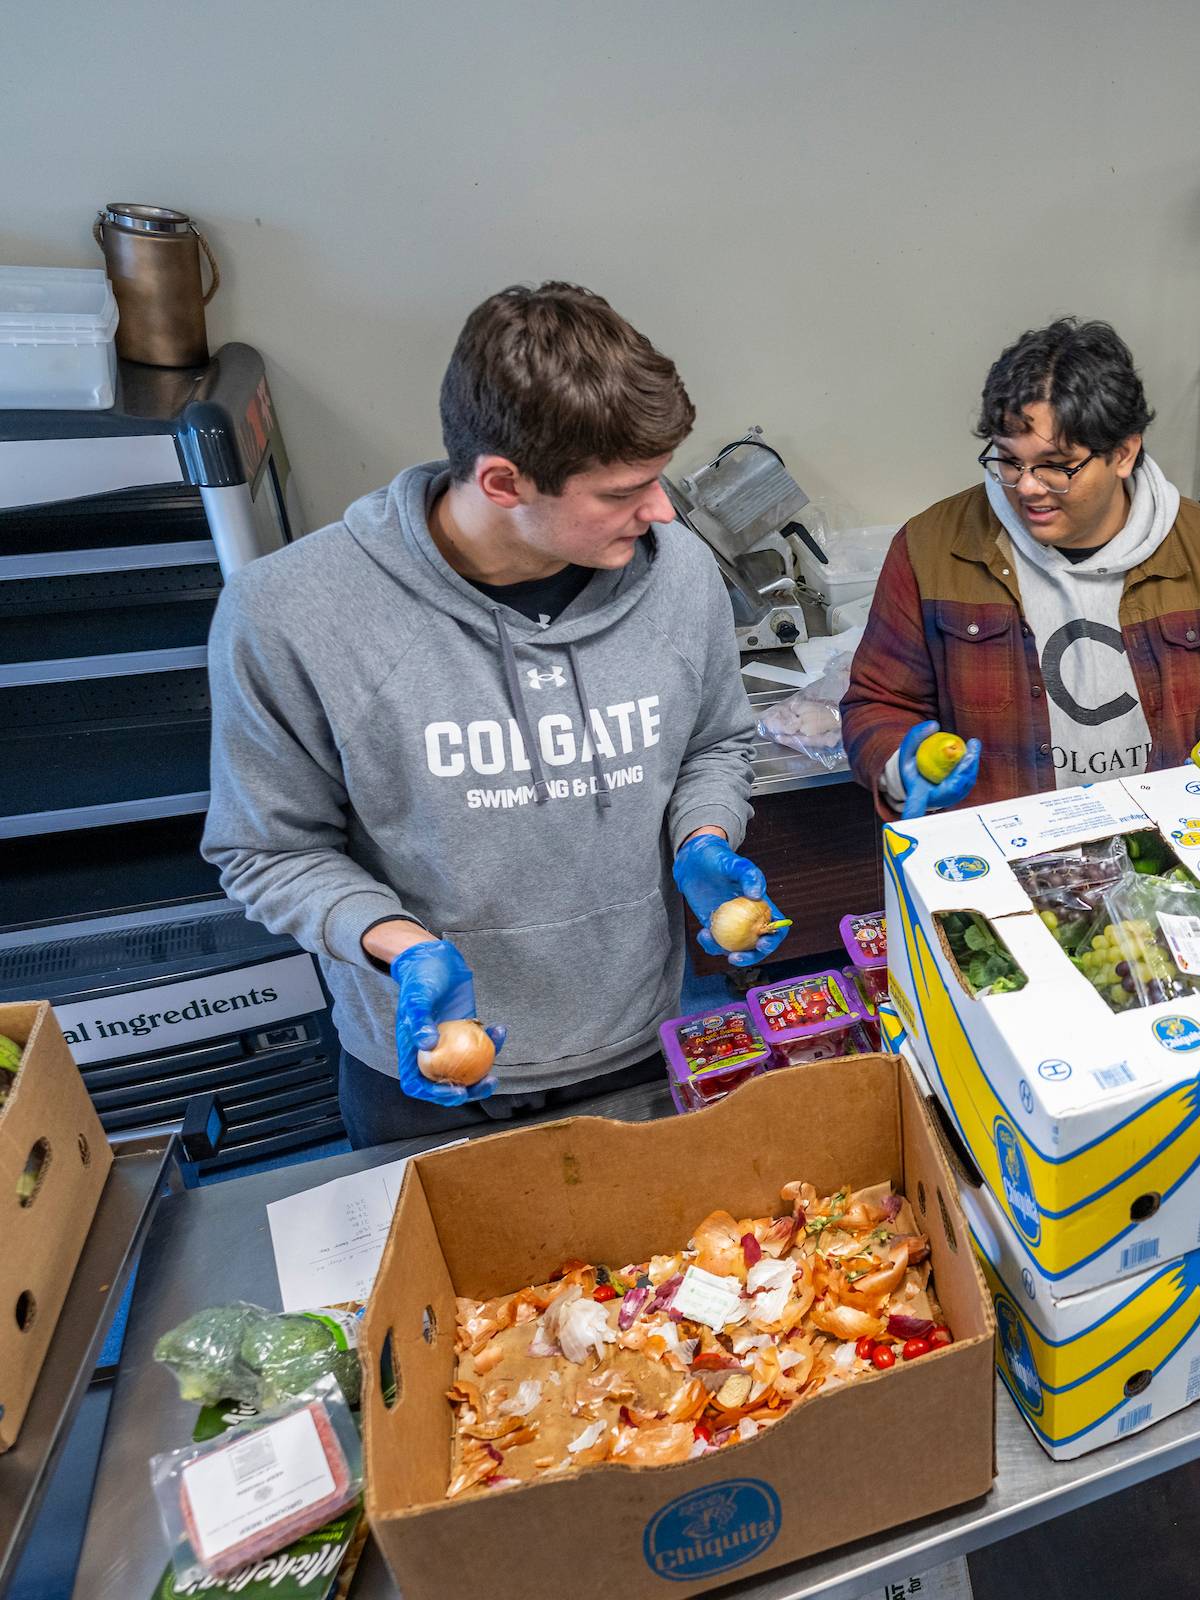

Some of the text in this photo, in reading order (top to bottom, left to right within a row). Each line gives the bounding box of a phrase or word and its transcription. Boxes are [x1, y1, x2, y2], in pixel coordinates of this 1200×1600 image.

[1041, 618, 1139, 727] C
[424, 695, 661, 778] COLGATE
[466, 764, 644, 809] SWIMMNG & DVING
[94, 986, 279, 1037] ingredients
[655, 1519, 772, 1571] Chiquita
[908, 1576, 922, 1594] for
